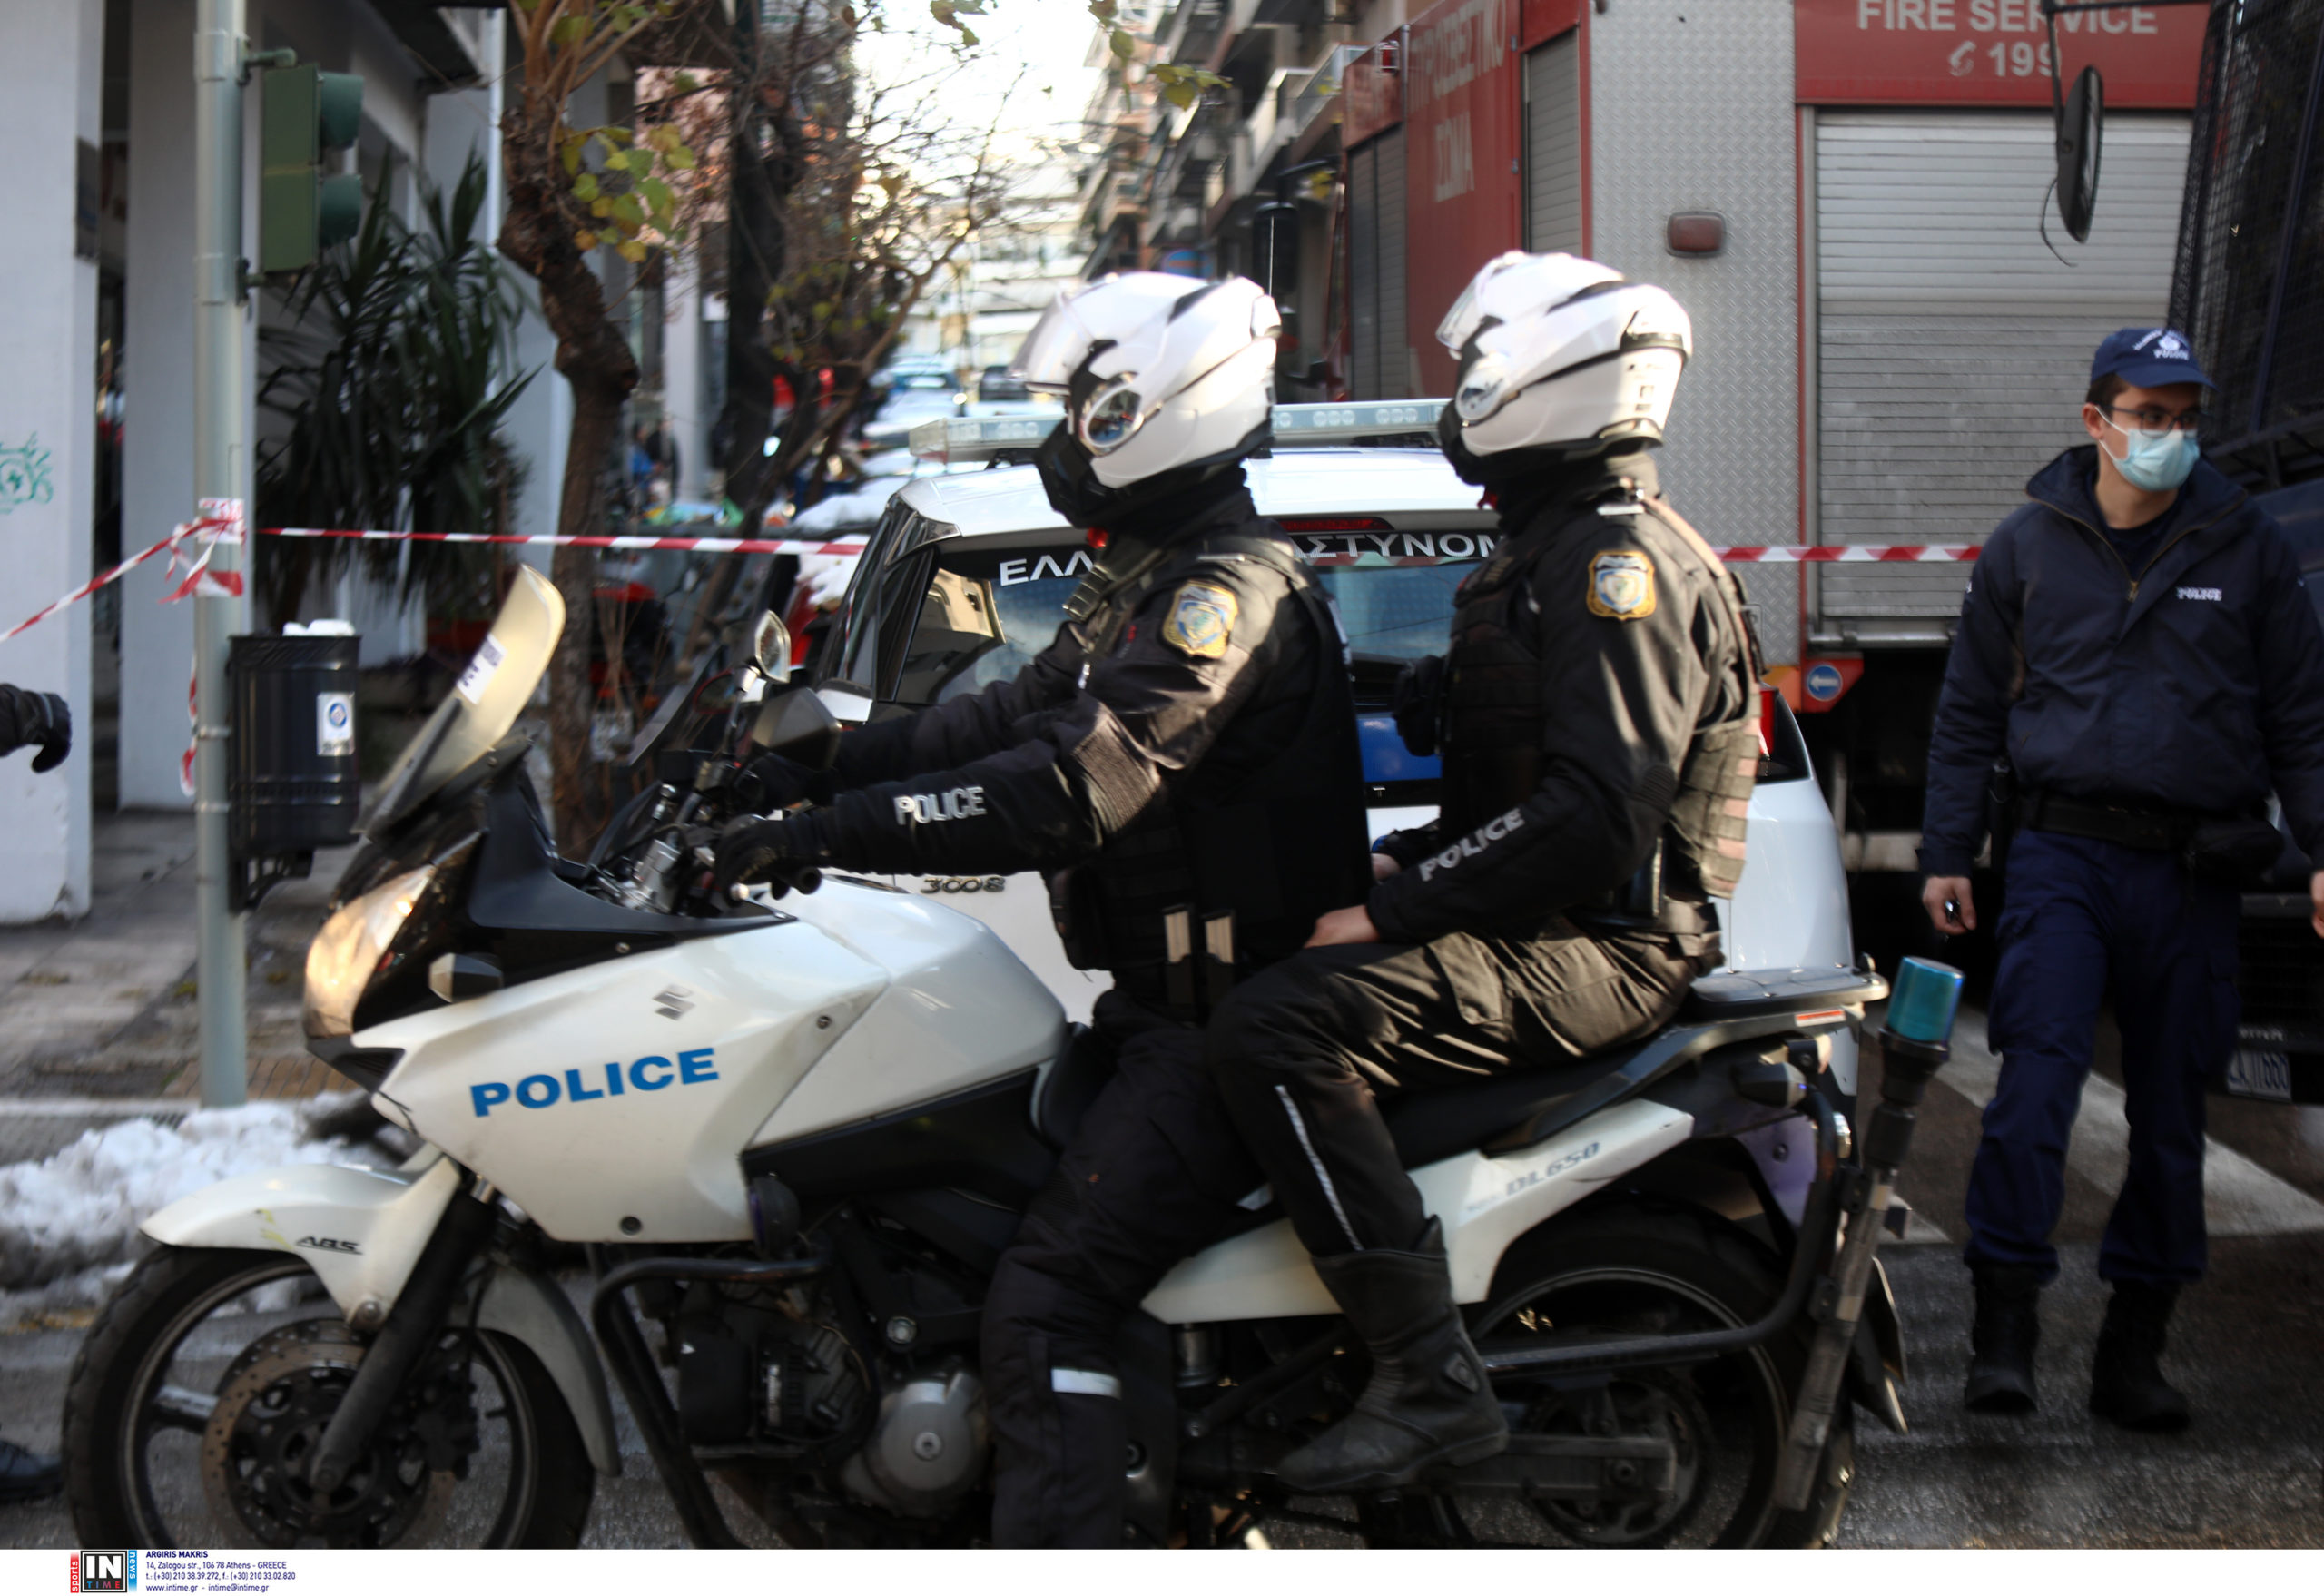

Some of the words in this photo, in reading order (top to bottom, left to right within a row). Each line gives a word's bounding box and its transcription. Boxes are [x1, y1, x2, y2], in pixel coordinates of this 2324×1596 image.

[1856, 0, 1956, 30] FIRE
[1987, 41, 2062, 77] 199
[2176, 586, 2222, 601] POLICE
[893, 786, 987, 825] POLICE
[1419, 807, 1525, 882] POLICE
[921, 875, 1005, 893] 3008
[470, 1047, 719, 1118] POLICE
[296, 1235, 361, 1252] ABS
